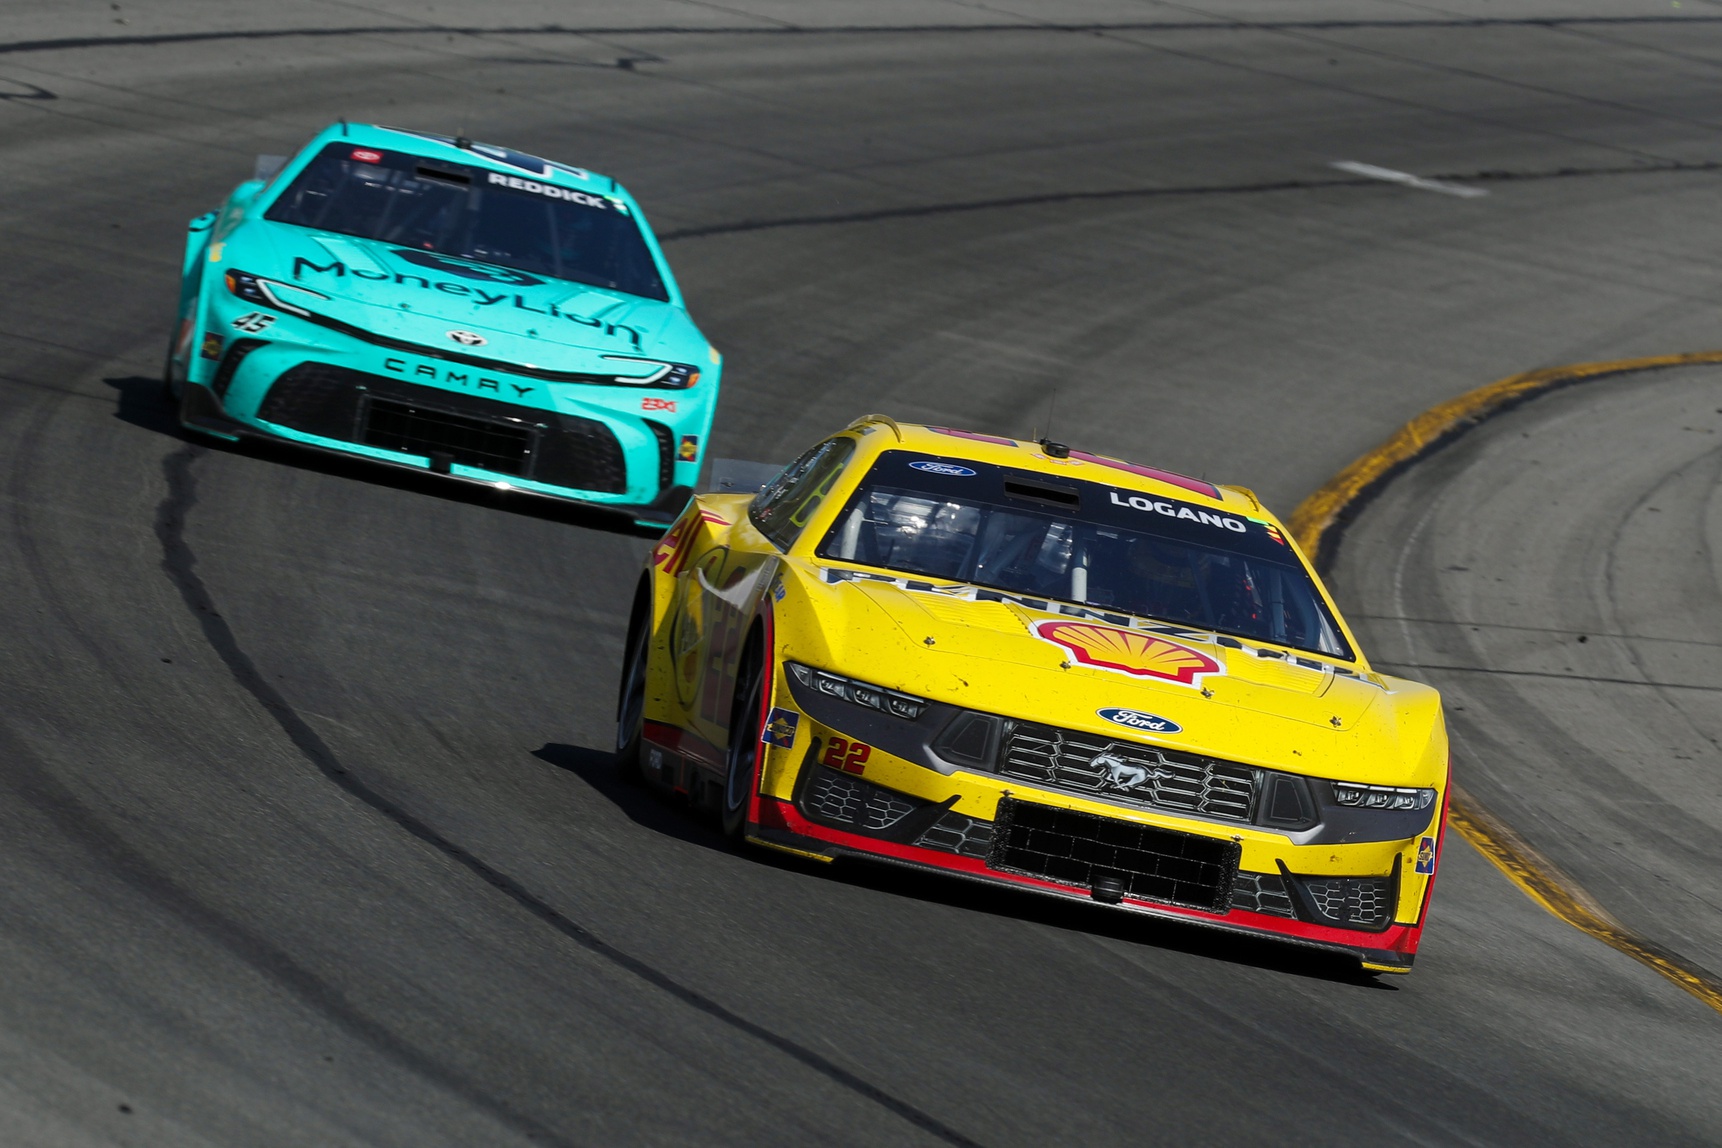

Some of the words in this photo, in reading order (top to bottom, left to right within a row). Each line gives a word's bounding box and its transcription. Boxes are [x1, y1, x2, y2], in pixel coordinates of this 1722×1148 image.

[488, 172, 606, 209] REDDICK
[231, 311, 277, 333] 45
[293, 256, 643, 352] MoneyLion
[384, 357, 536, 398] CAMRY
[921, 463, 964, 475] Ford
[1110, 491, 1248, 533] LOGANO
[1112, 710, 1166, 731] Ford
[822, 736, 872, 775] 22
